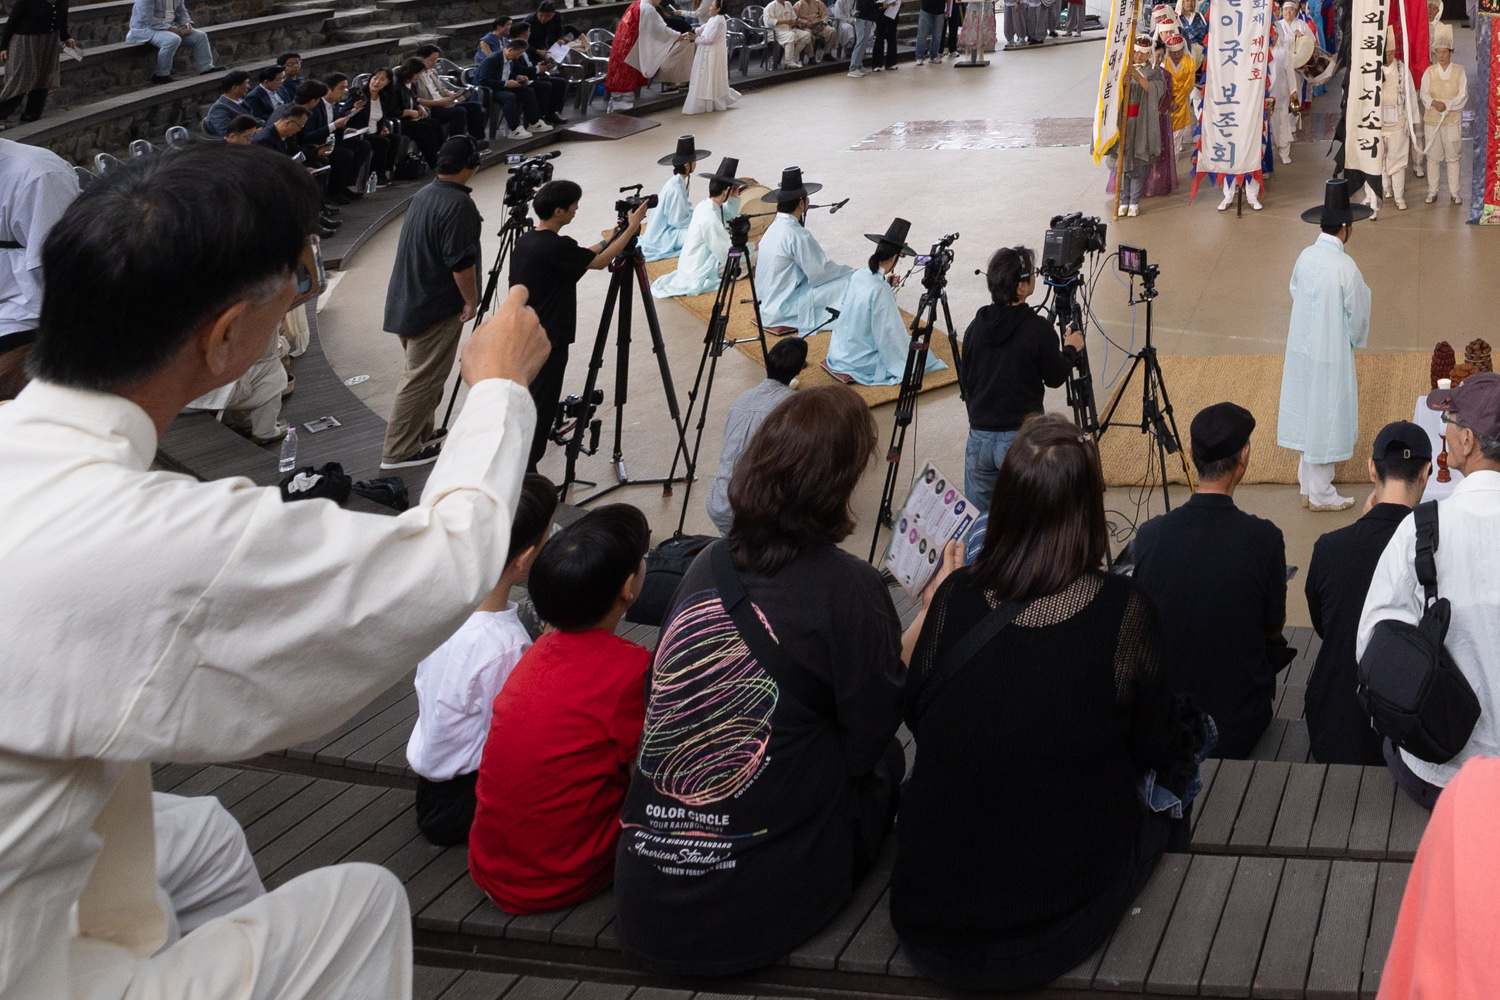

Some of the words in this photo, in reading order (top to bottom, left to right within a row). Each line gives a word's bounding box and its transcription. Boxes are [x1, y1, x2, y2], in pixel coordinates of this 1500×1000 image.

[1210, 83, 1241, 169] 보존회
[734, 780, 754, 799] COLOR
[753, 755, 772, 780] CIRCLE
[645, 803, 686, 819] COLOR
[687, 810, 730, 826] CIRCLE
[649, 819, 669, 829] YOUR
[634, 830, 653, 841] BUILT
[652, 835, 661, 843] TO
[666, 838, 693, 847] HIGHER
[694, 840, 733, 849] STANDARD
[662, 866, 685, 876] ANDREW
[685, 866, 714, 877] FOREM
[715, 859, 737, 870] DESIGN
